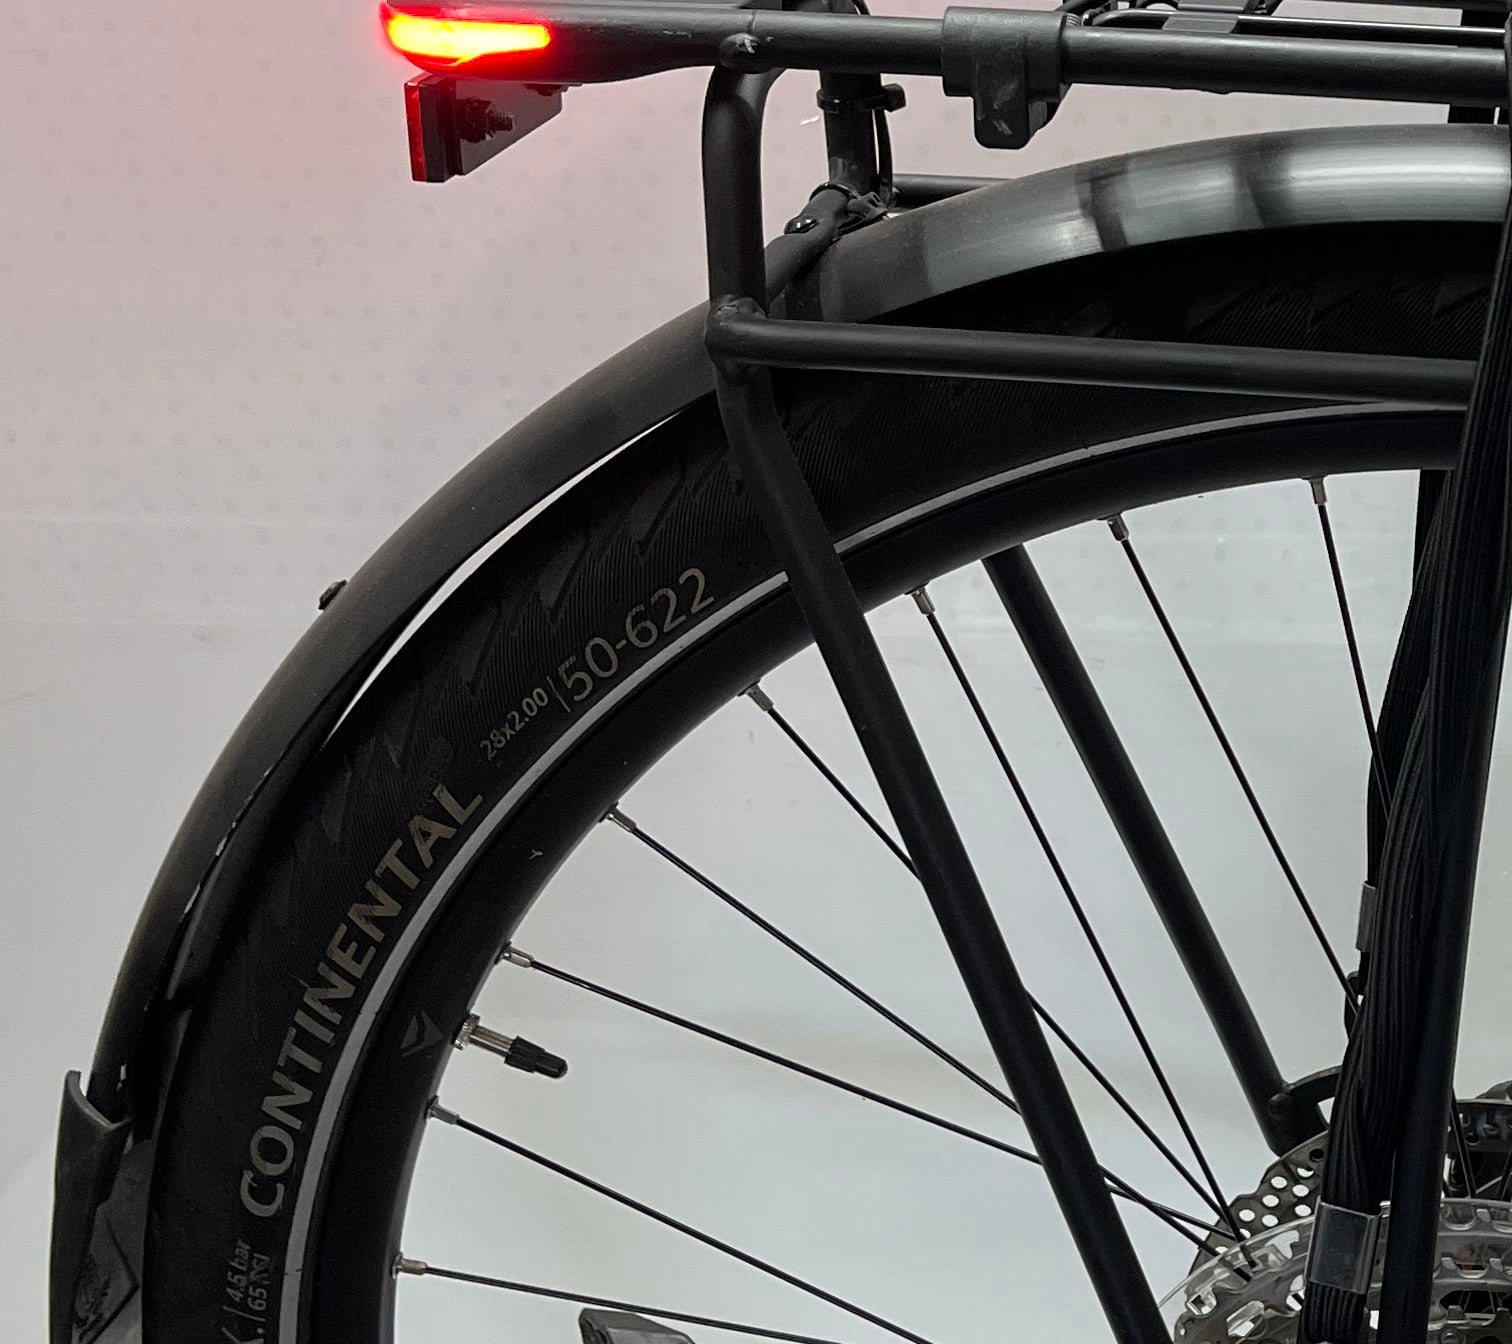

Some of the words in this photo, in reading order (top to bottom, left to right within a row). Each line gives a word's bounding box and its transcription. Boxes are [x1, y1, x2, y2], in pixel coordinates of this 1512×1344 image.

[480, 686, 550, 760] 28x2.00
[556, 566, 716, 703] 50-622
[239, 783, 483, 1219] CONTINENTAL
[247, 1284, 269, 1312] 65
